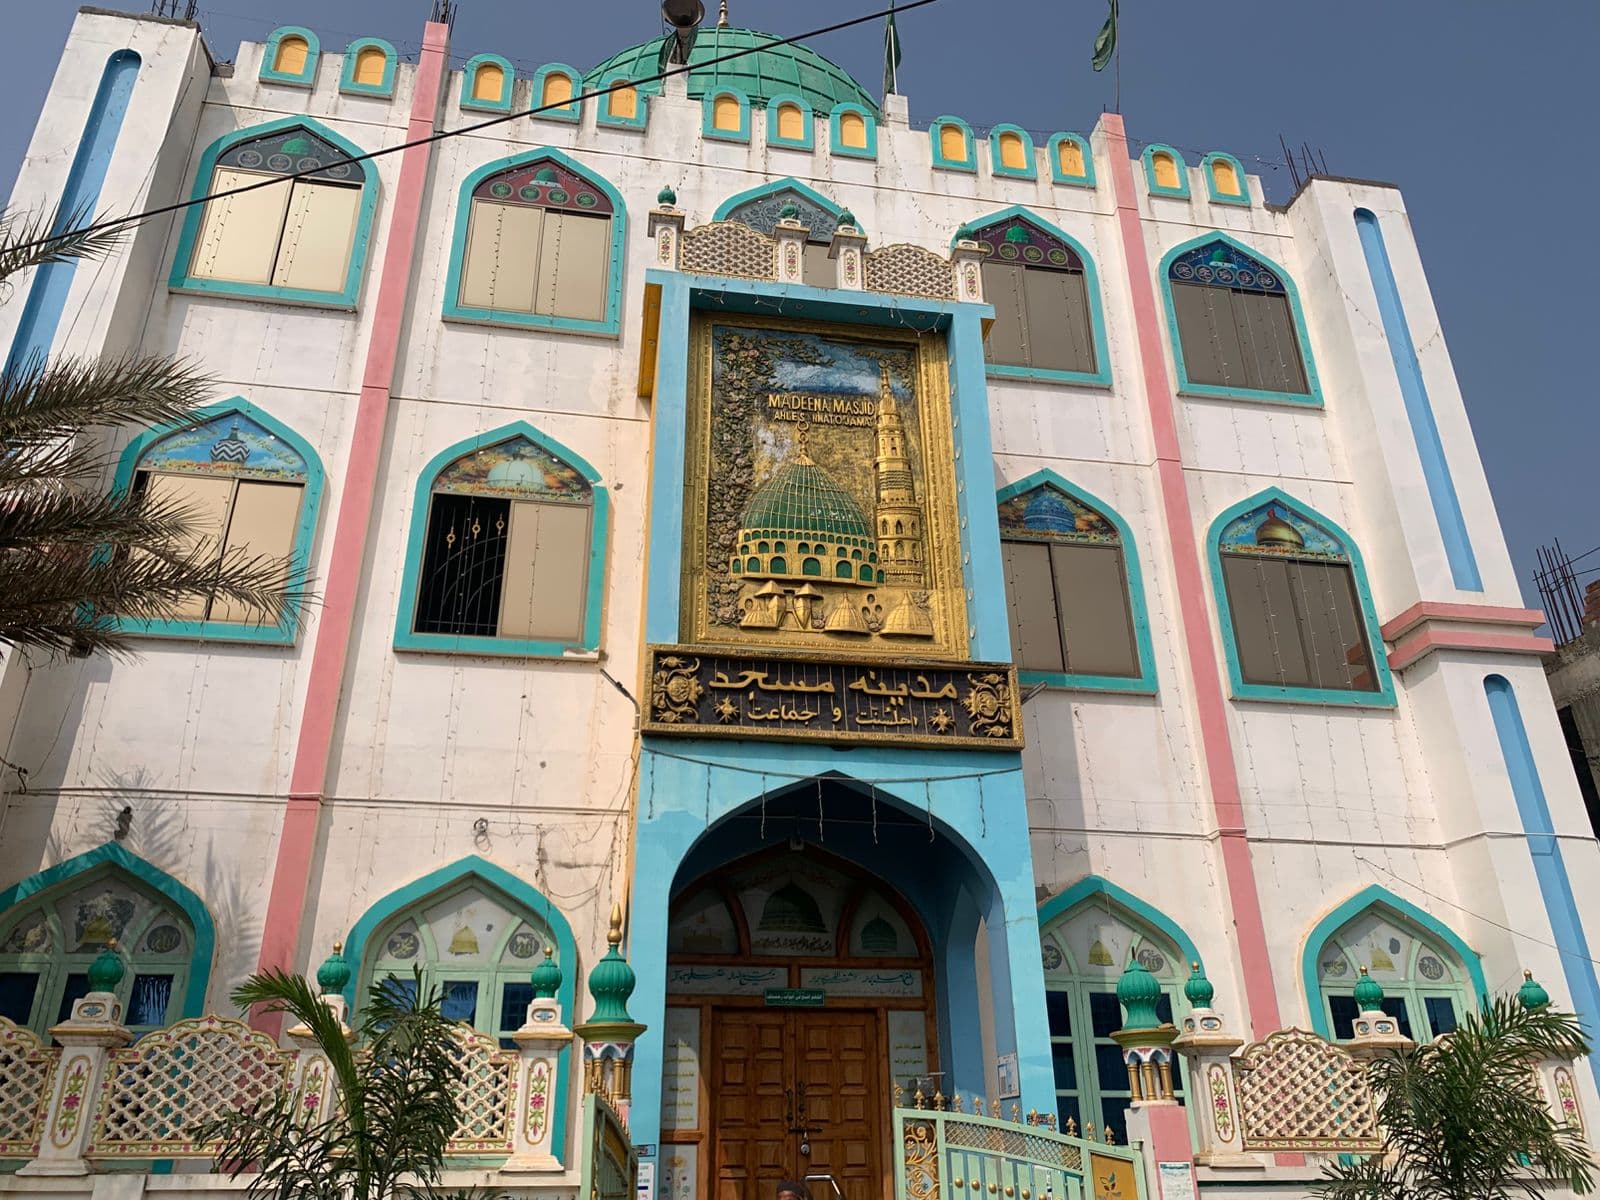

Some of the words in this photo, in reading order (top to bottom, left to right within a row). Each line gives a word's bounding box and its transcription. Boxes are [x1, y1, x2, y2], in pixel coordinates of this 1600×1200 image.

[768, 394, 830, 411] MADEENA
[833, 399, 875, 416] MASJID
[708, 670, 835, 701] مسجد
[747, 704, 818, 726] جماعت
[832, 706, 842, 723] و
